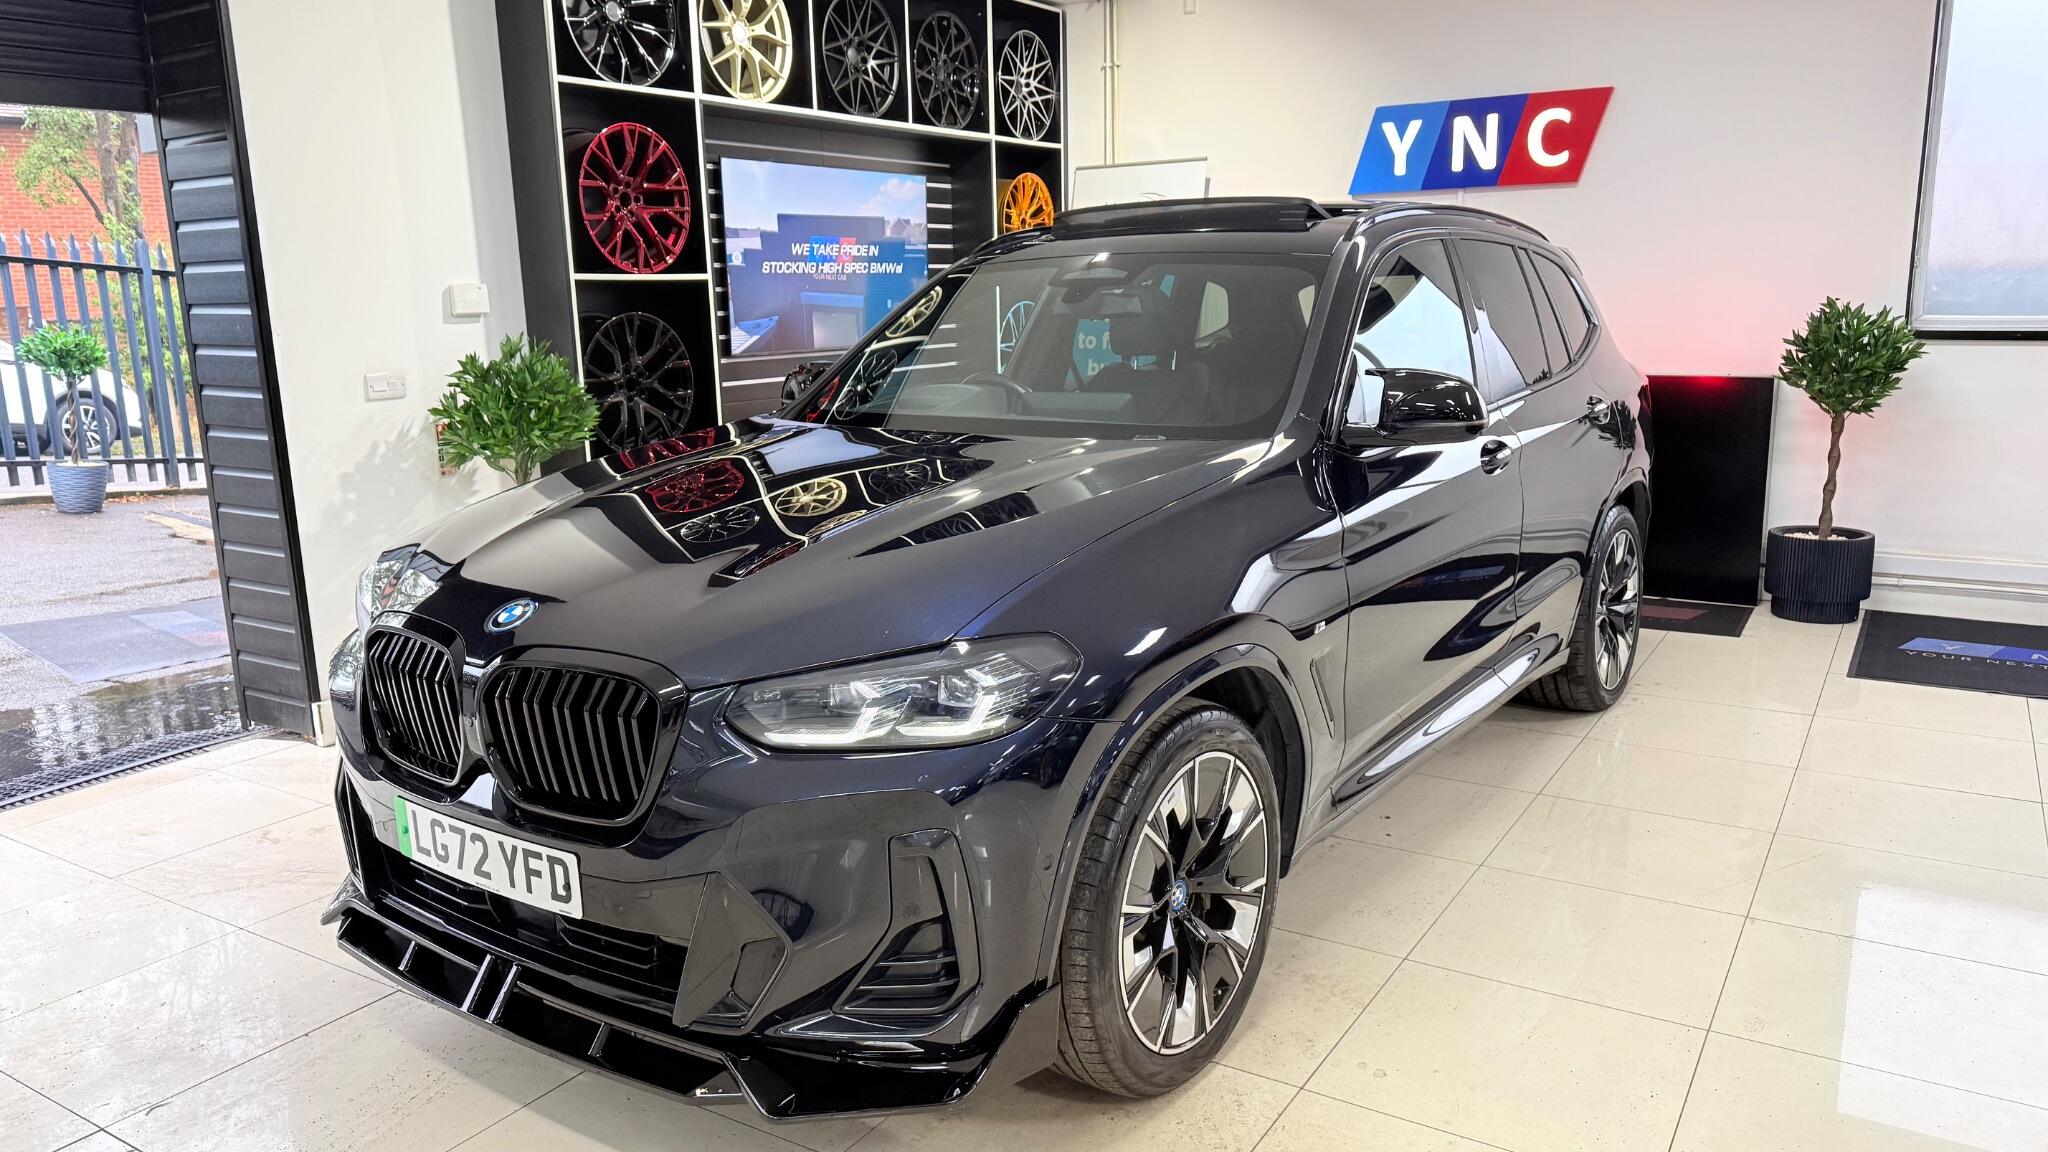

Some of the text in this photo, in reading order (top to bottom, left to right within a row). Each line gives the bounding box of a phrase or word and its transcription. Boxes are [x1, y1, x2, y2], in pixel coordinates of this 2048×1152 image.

[1381, 107, 1572, 177] YNC
[791, 243, 879, 257] WE TAKE PRIDE IN
[762, 261, 816, 274] STOCKING
[818, 262, 842, 274] HIGH
[844, 262, 869, 274] SPEC
[1078, 332, 1097, 350] to
[1904, 650, 1973, 662] YOUR
[411, 809, 572, 904] LG72 YFD
